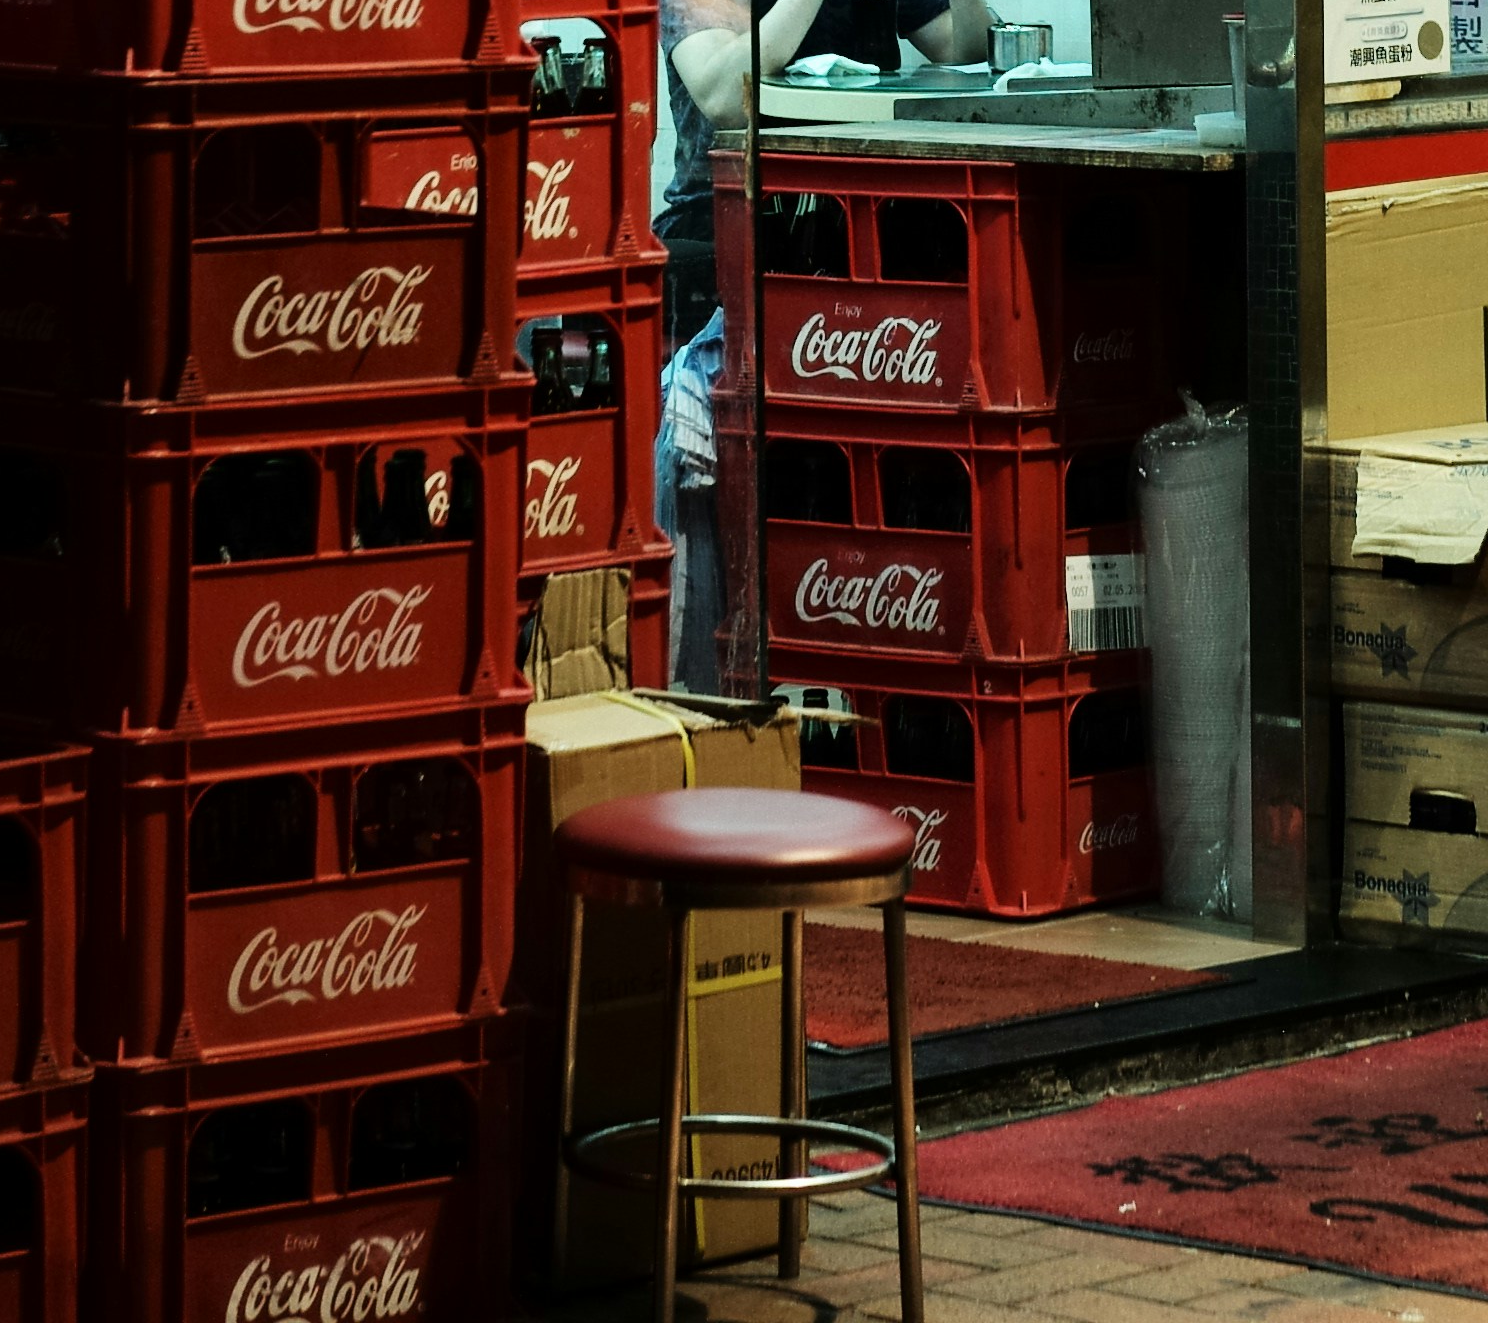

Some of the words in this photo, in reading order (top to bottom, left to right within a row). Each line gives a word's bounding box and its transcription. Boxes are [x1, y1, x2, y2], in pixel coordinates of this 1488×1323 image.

[1350, 44, 1412, 67] 潮興魚蛋粉
[233, 264, 432, 360] Coca-Cola
[834, 302, 862, 317] Enjoy
[791, 312, 942, 385] Coca-Cola
[795, 557, 944, 634] Coca-Cola
[233, 583, 434, 688] Coca-Cola
[1334, 626, 1404, 651] Bonaqua
[1079, 813, 1139, 855] Coca-Cola
[1354, 870, 1428, 898] Bonaqua
[227, 903, 428, 1014] Coca-Cola
[225, 1228, 425, 1323] Coca-Cola
